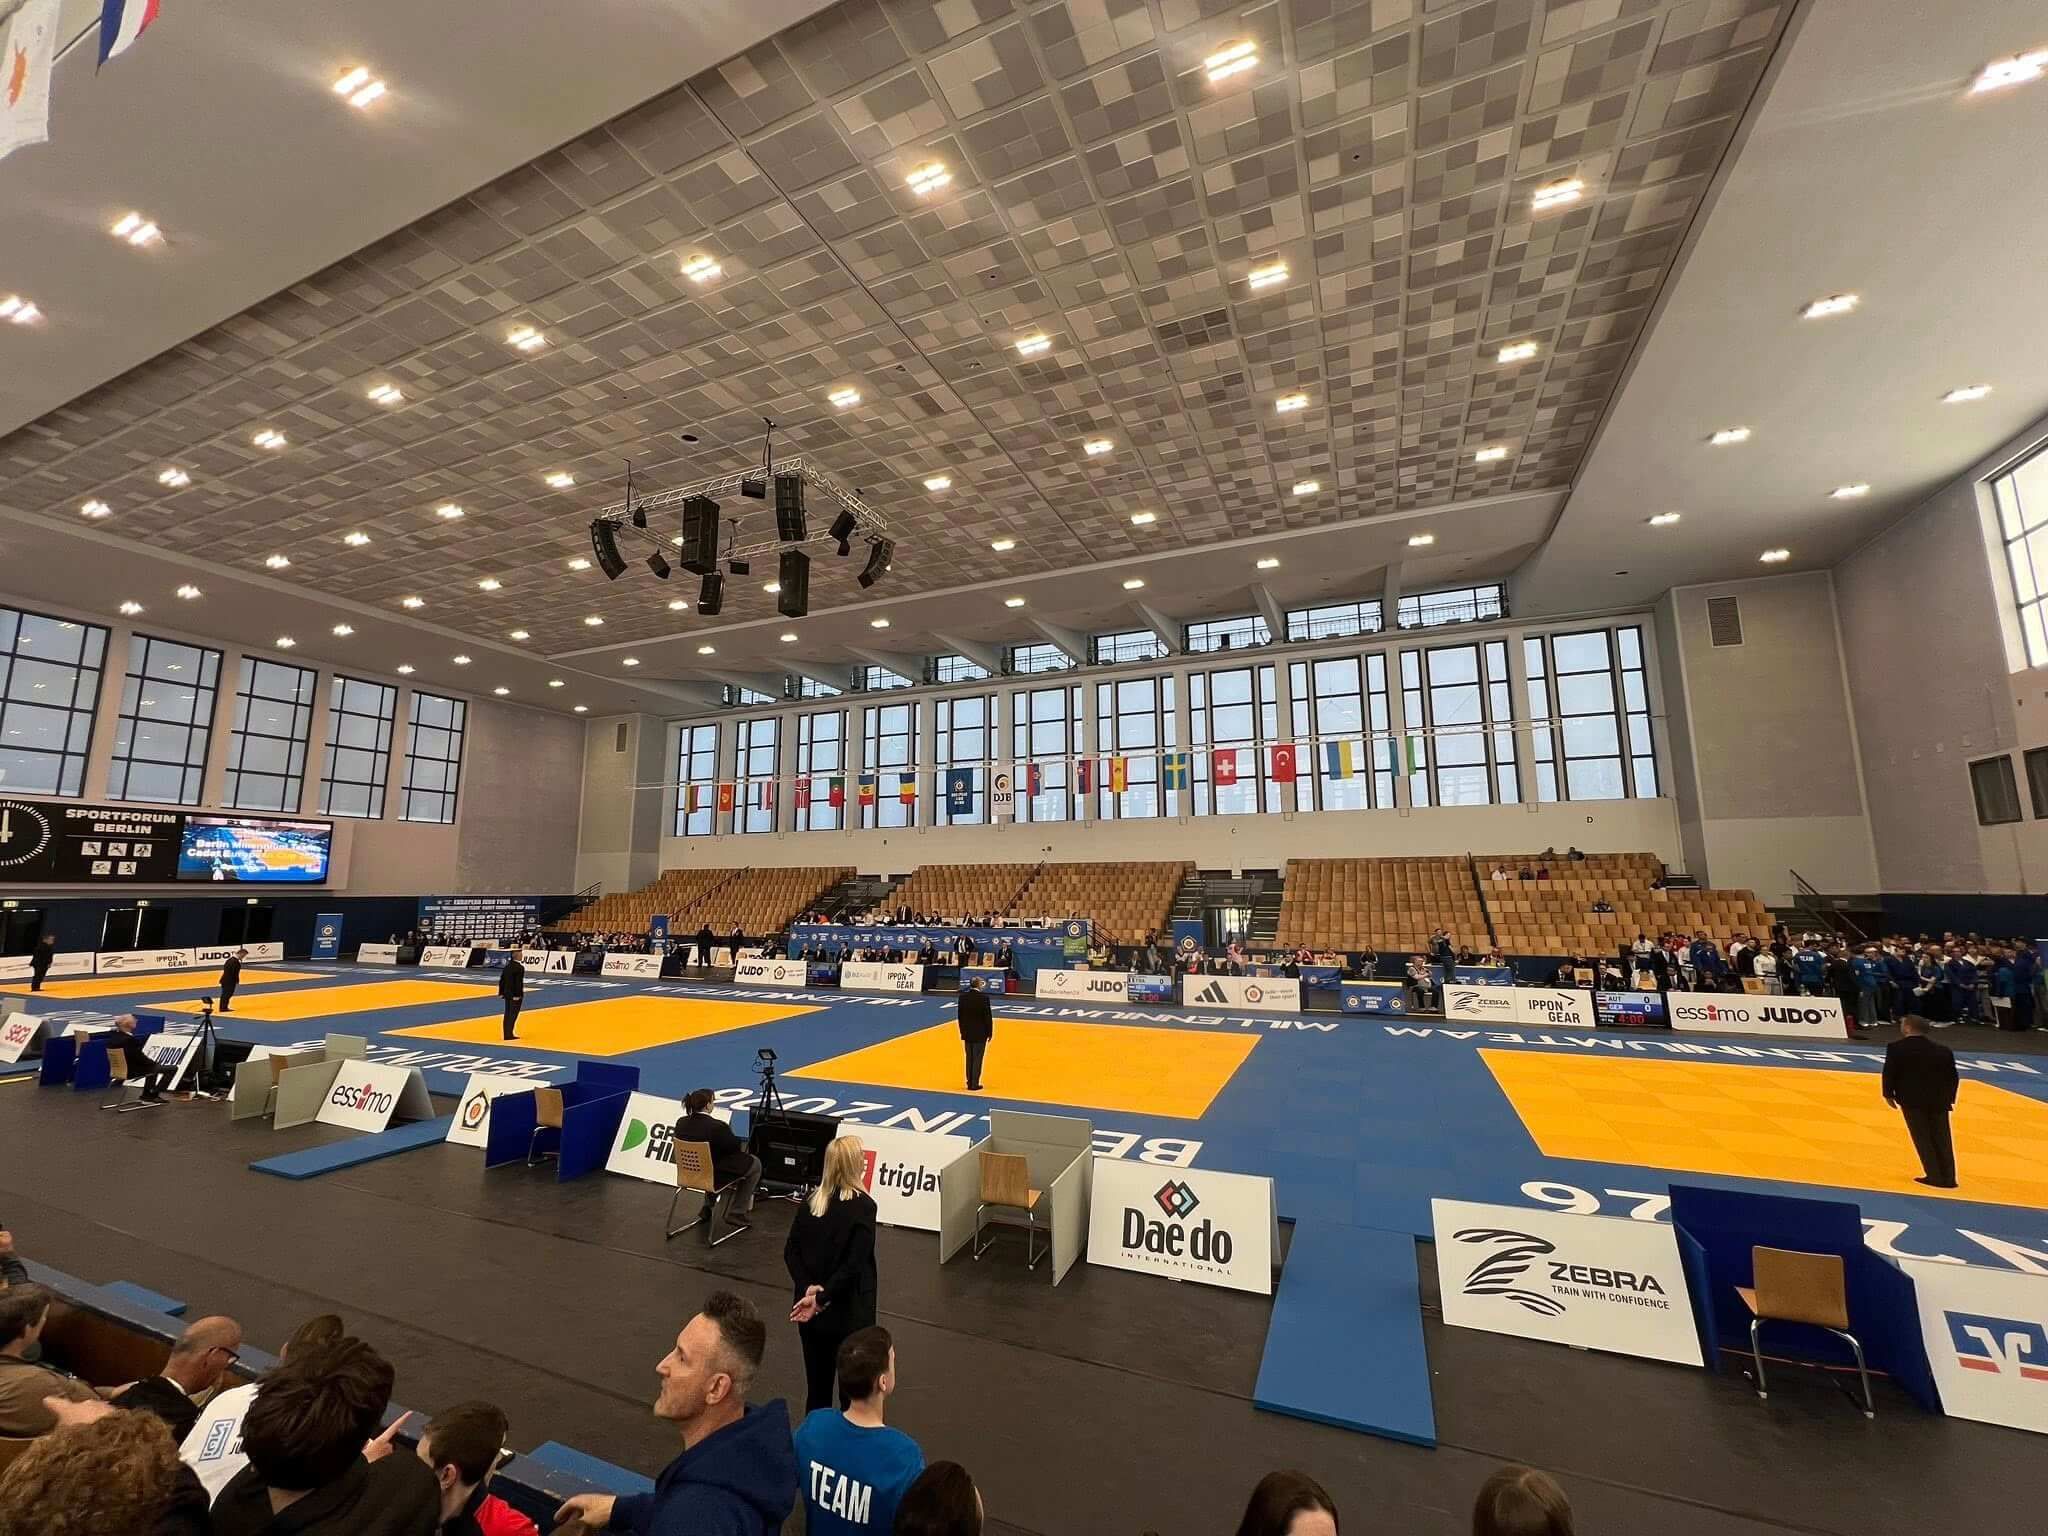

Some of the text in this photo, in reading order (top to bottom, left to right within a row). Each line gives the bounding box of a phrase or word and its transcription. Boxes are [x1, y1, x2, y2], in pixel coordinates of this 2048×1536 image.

[993, 793, 1012, 802] DJB
[65, 808, 177, 823] SPORTFORUM
[93, 823, 152, 834] BERLIN
[199, 951, 231, 961] JUDO
[738, 966, 764, 976] JUDO
[887, 972, 907, 981] IPPON
[896, 980, 915, 990] GEAR
[1086, 979, 1123, 992] JUDO
[1528, 999, 1564, 1011] IPPON
[1643, 996, 1650, 1004] 0
[1644, 1004, 1652, 1012] 0
[1548, 1011, 1581, 1024] GEAR
[1675, 1004, 1750, 1022] essimo
[1758, 1007, 1822, 1025] JUDO
[331, 1083, 393, 1114] essimo
[1121, 1251, 1233, 1276] INTERNATIONAL
[1547, 1260, 1666, 1296] ZEBRA
[1551, 1284, 1672, 1311] TRAIN WITH CONFIDENCE
[809, 1459, 873, 1525] TEAM
